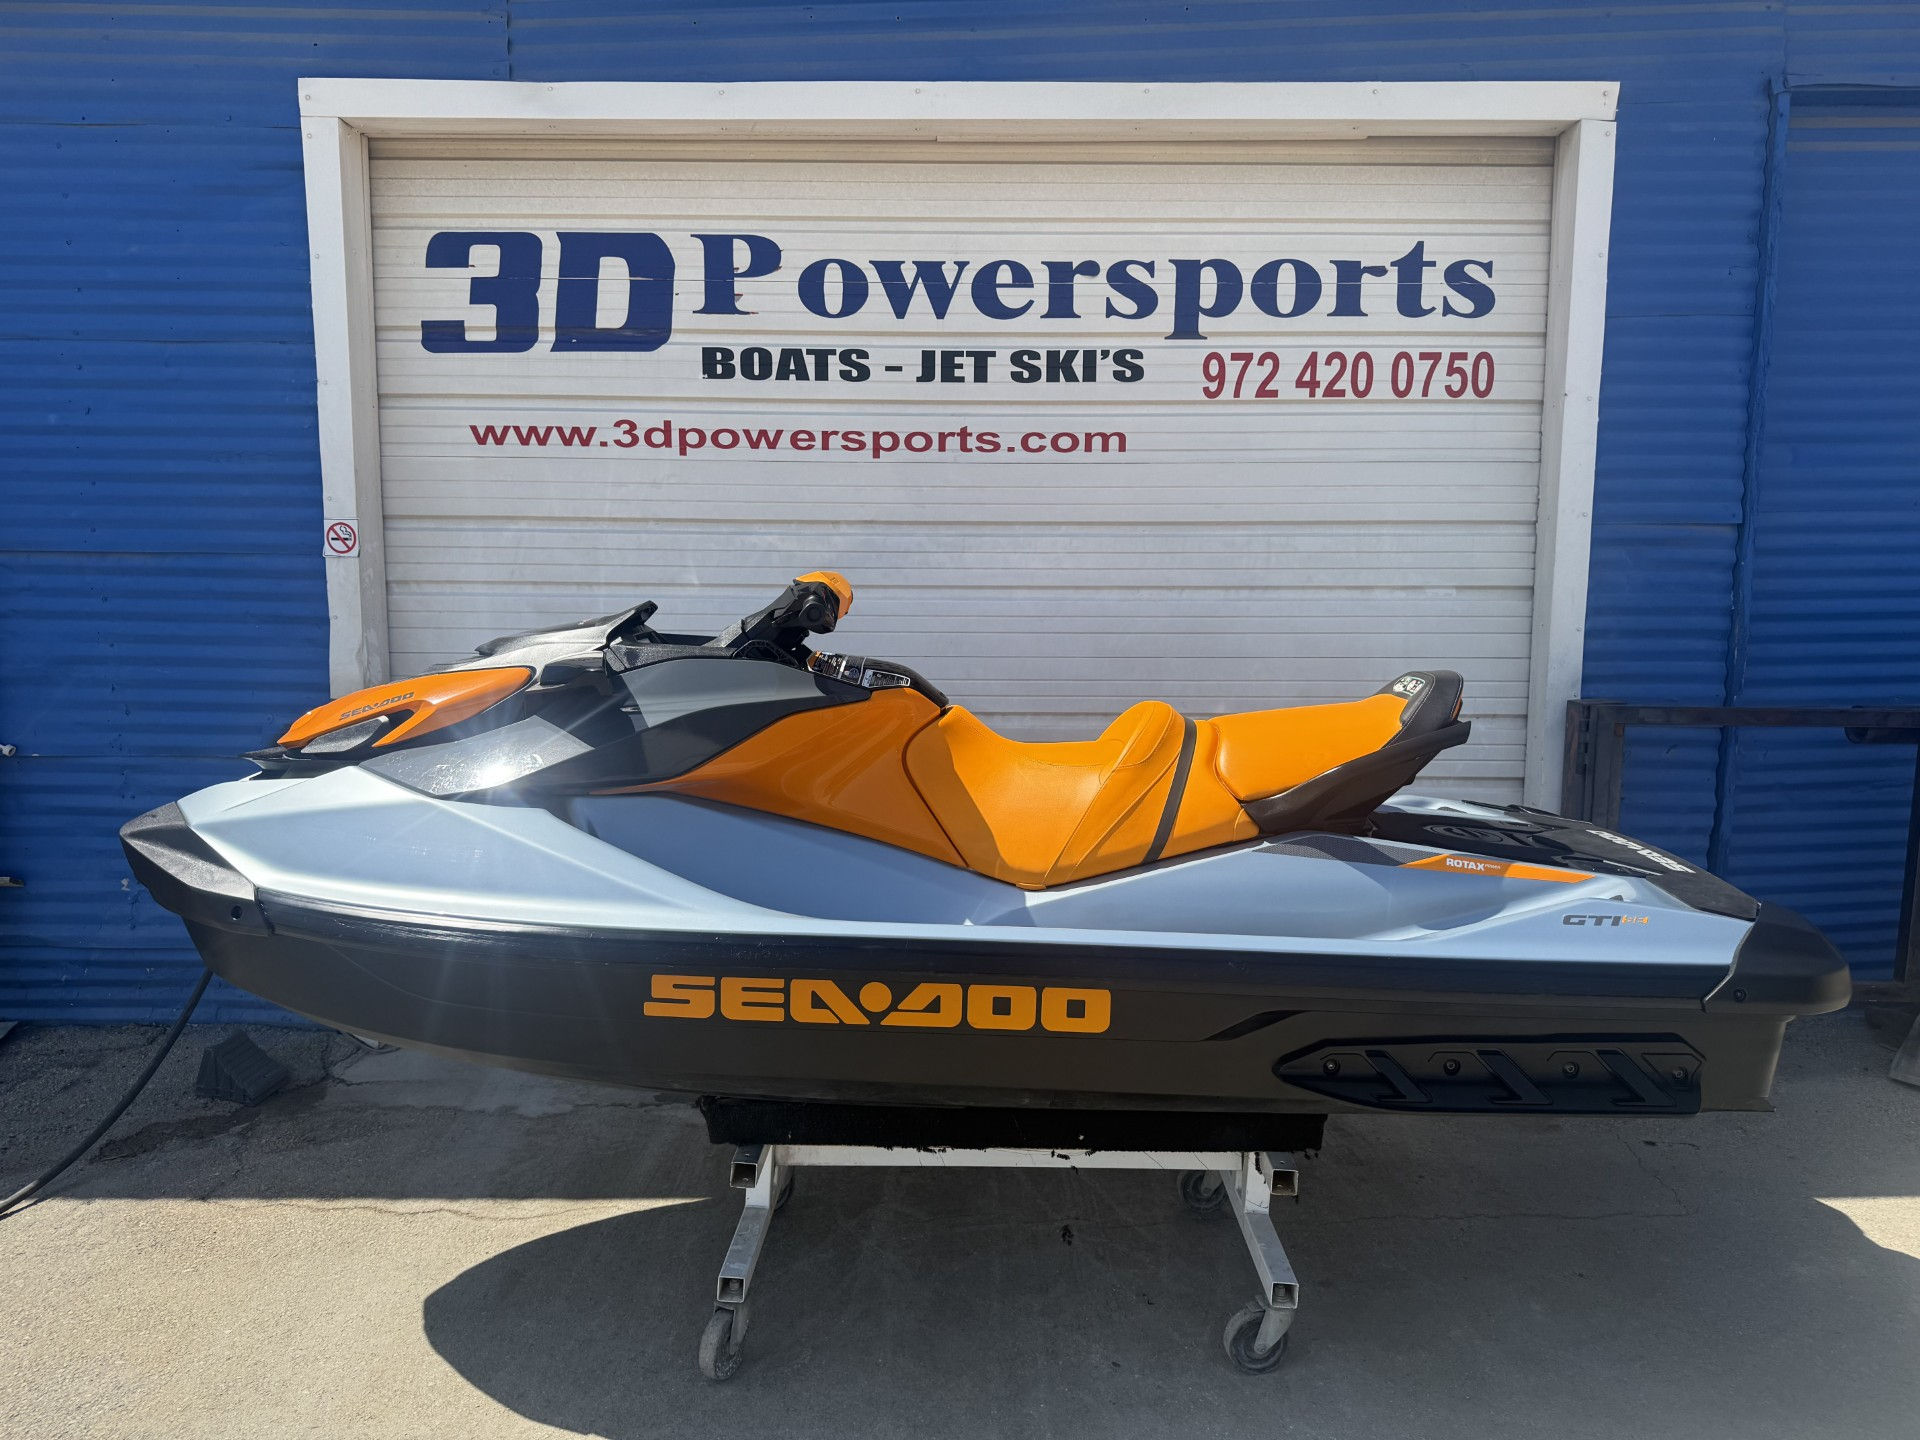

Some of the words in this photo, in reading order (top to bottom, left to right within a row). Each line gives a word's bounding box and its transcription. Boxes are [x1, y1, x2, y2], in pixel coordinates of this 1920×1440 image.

[420, 231, 676, 354] 3D
[690, 233, 1496, 340] Powersports
[701, 346, 871, 382] BOATS
[916, 349, 997, 383] JET
[1010, 348, 1145, 384] SKI'S
[1202, 351, 1280, 399] 972
[1295, 351, 1374, 399] 420
[1390, 351, 1495, 399] 0750
[469, 418, 1127, 459] www.3dpowersports.com
[1446, 857, 1485, 871] ROTAX
